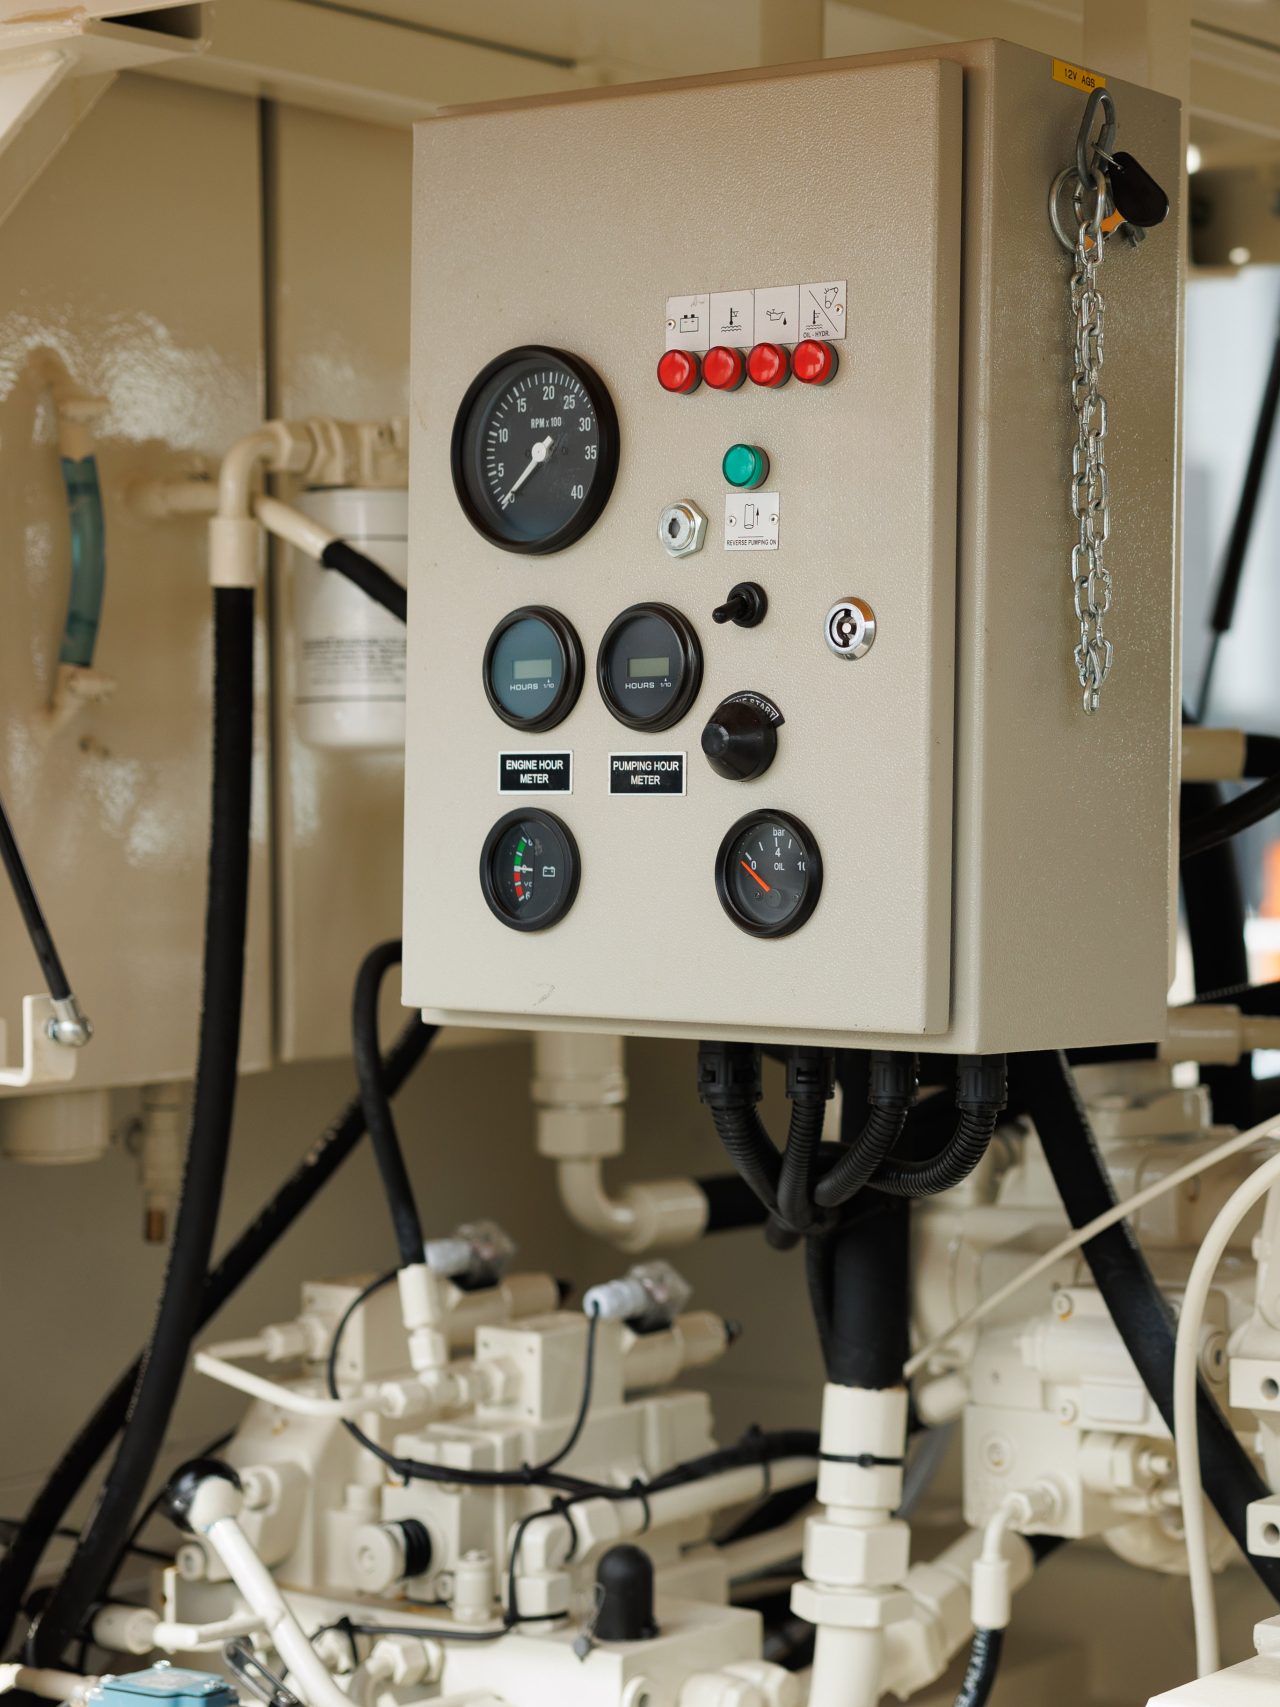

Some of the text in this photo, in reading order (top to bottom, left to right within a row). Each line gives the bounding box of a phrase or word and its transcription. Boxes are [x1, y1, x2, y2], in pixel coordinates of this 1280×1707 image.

[1064, 68, 1077, 80] 12V
[542, 385, 555, 400] 20
[517, 398, 527, 413] 15
[563, 395, 576, 410] 25
[530, 418, 545, 429] RPM
[550, 416, 562, 427] 100
[578, 417, 591, 431] 30
[498, 428, 508, 443] 10
[584, 445, 597, 460] 35
[497, 463, 505, 478] 5
[570, 484, 584, 500] 40
[769, 538, 777, 546] ON
[510, 682, 539, 691] HOURS
[625, 681, 655, 690] HOURS
[505, 759, 564, 771] ENGINE HOUR
[613, 761, 680, 772] PUMPING HOUR
[519, 773, 549, 784] METER
[630, 775, 661, 785] METER
[772, 827, 786, 836] bar
[774, 847, 781, 857] 4
[751, 860, 757, 870] 0
[773, 862, 785, 871] OIL
